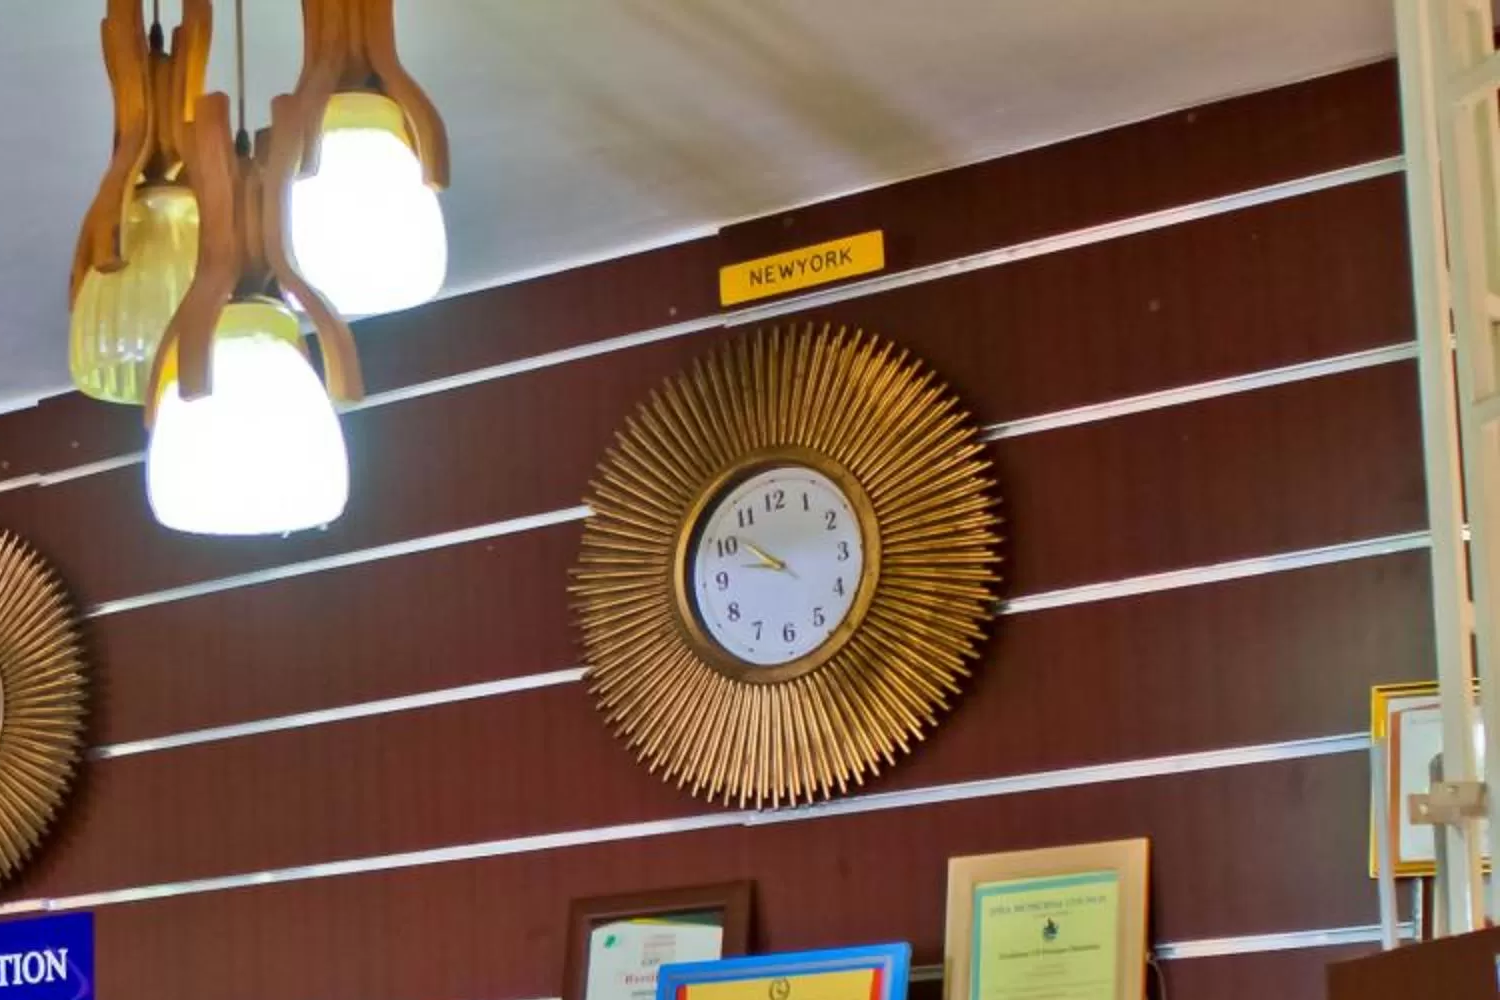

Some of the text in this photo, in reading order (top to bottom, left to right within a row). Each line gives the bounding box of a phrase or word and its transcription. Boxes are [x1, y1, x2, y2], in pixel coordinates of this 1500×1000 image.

[764, 490, 786, 513] 12
[802, 492, 810, 511] 1
[737, 507, 754, 528] 11
[825, 509, 837, 530] 2
[716, 535, 738, 558] 10
[837, 541, 849, 561] 3
[716, 571, 729, 591] 9
[833, 577, 844, 597] 4
[727, 602, 740, 621] 8
[813, 607, 825, 627] 5
[752, 620, 763, 641] 7
[783, 623, 796, 643] 6
